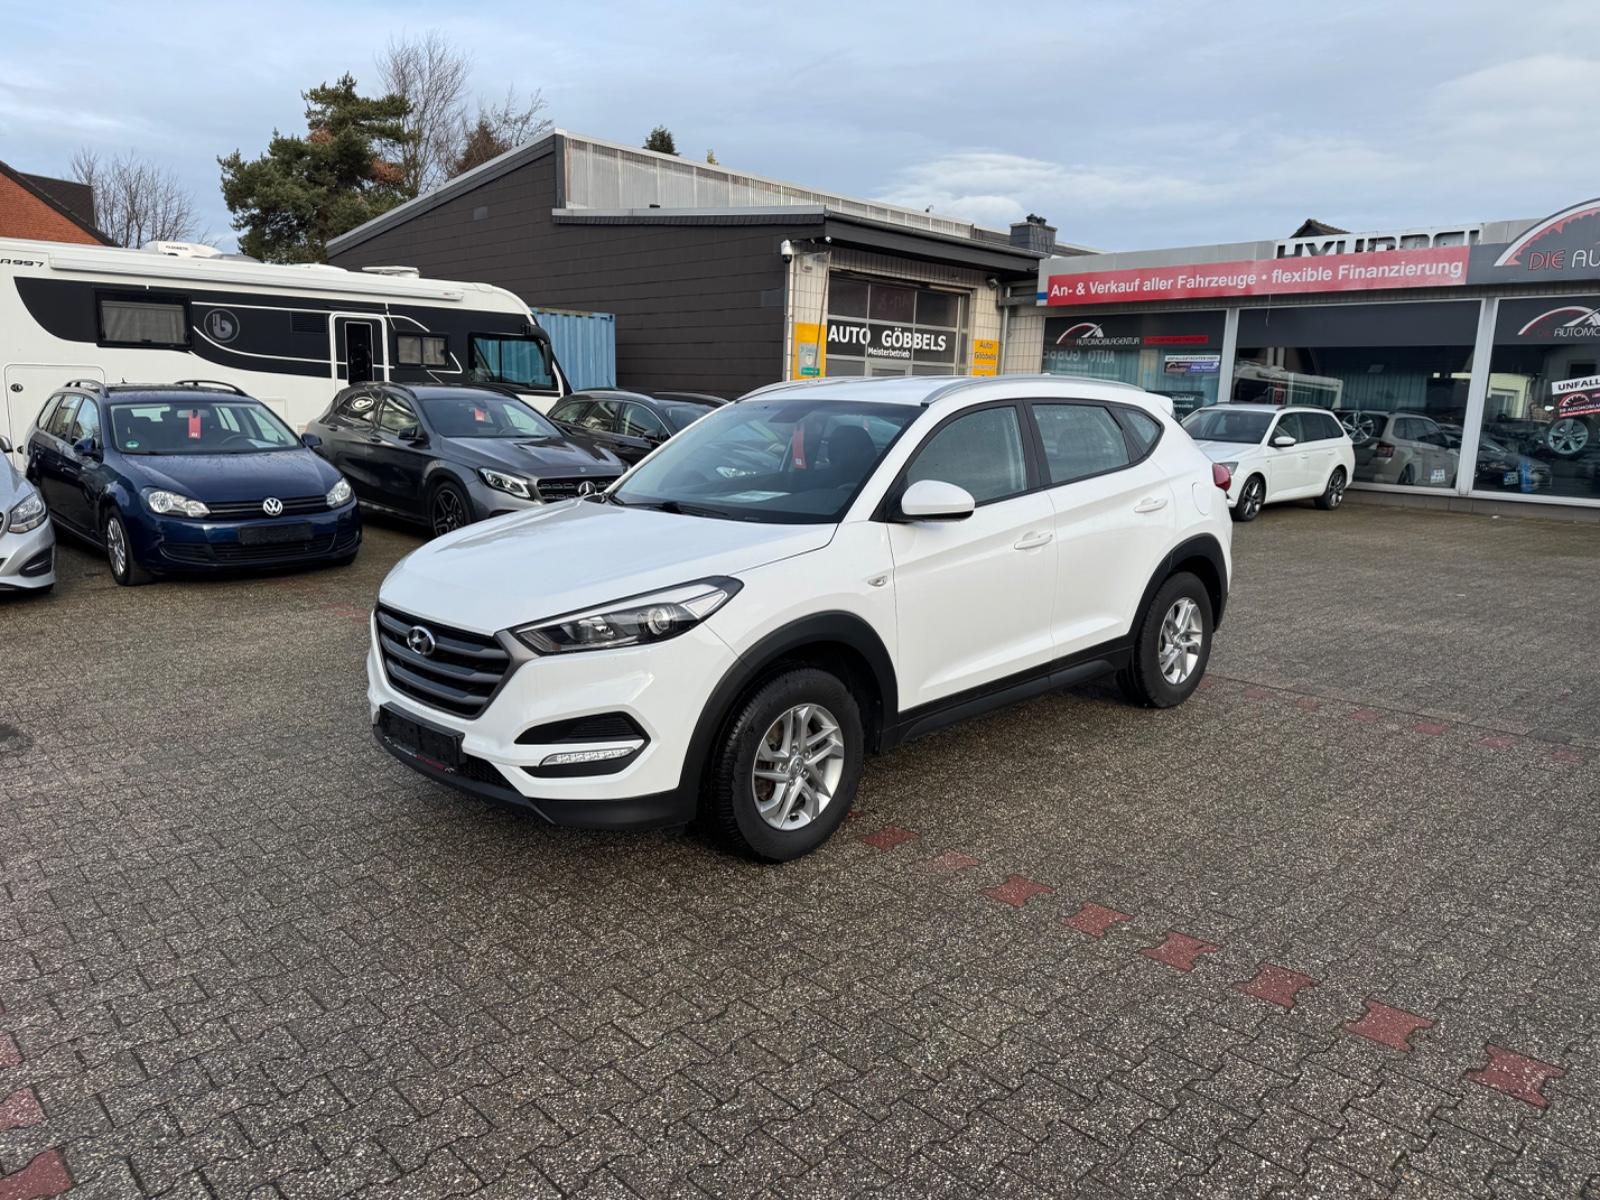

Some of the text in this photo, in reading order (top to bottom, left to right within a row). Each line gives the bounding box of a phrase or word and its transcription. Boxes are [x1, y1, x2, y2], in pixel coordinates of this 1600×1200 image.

[1528, 249, 1566, 271] DIE
[1051, 260, 1463, 297] An- & Verkauf aller Fahrzeuge flexible Finanzierung
[827, 325, 947, 351] AUTO GÖBBELS
[867, 346, 911, 358] Meisterbetrieb
[1557, 378, 1600, 391] UNFALL
